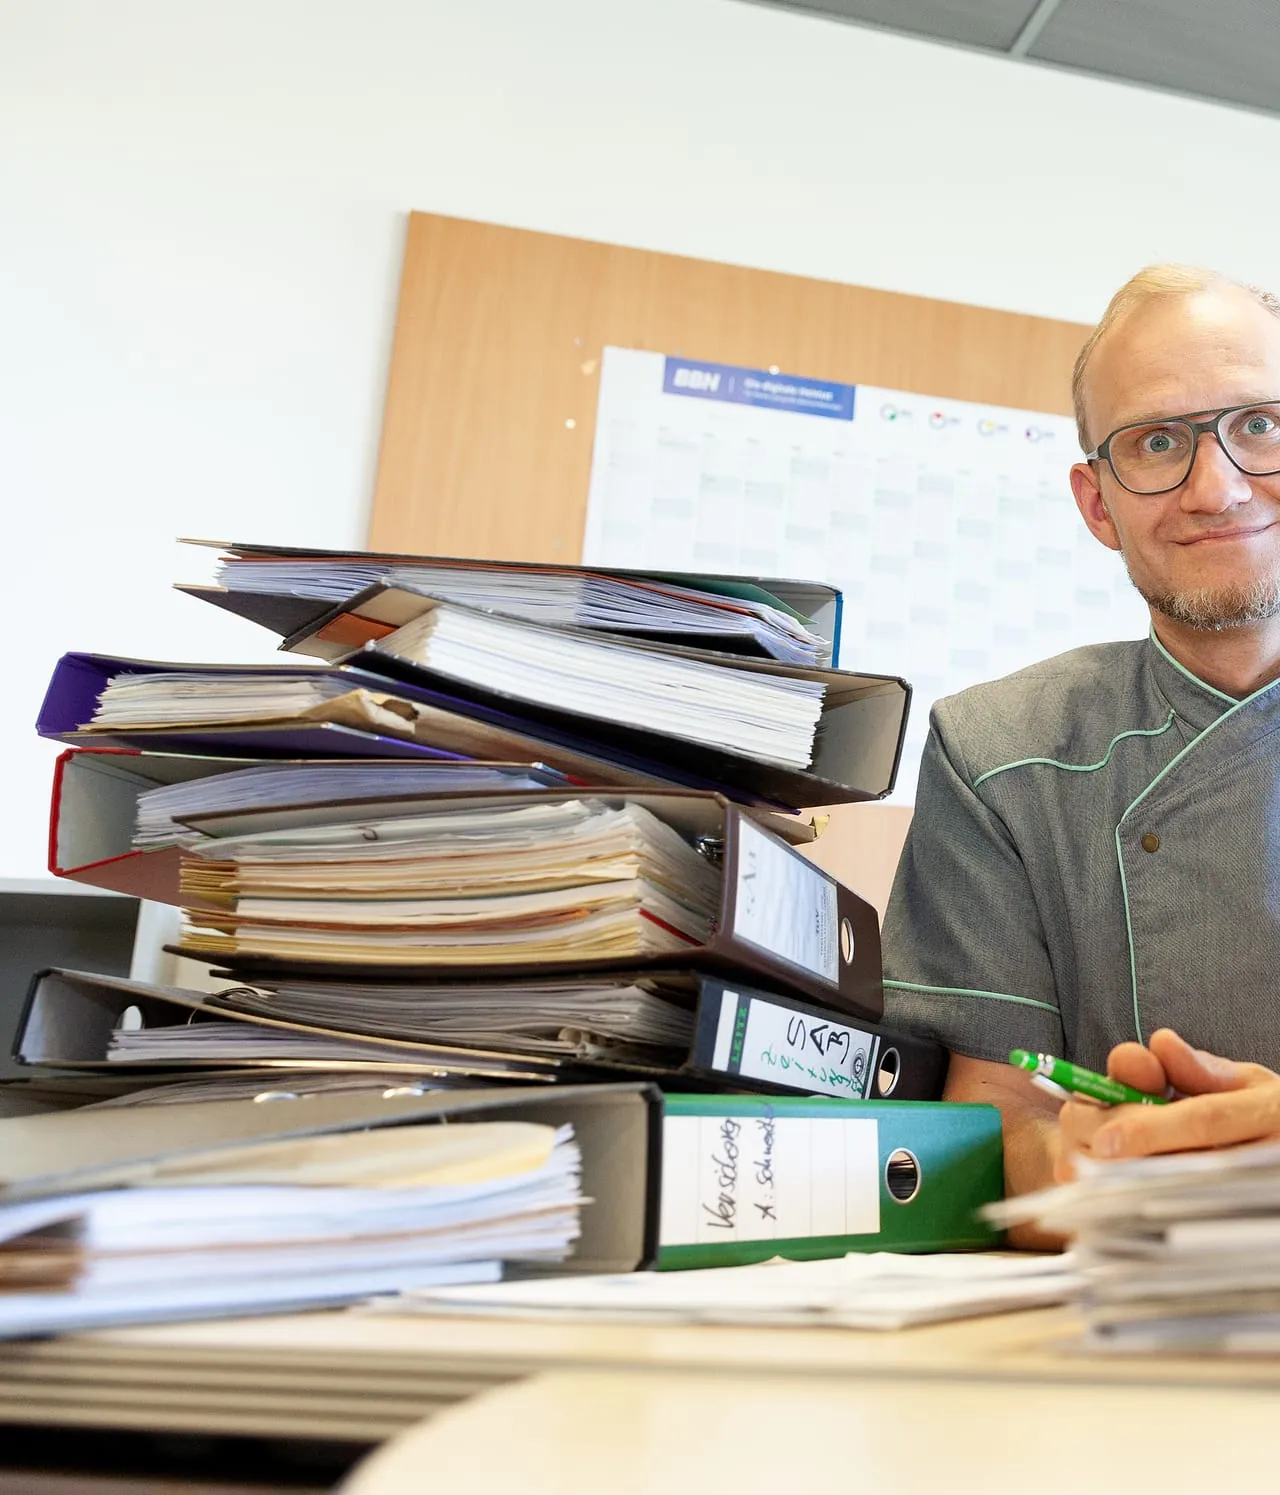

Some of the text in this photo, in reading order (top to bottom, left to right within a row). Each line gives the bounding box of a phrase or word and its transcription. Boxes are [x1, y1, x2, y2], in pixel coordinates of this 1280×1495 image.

[673, 367, 721, 392] BBN
[731, 1007, 748, 1063] LEITZ
[786, 1015, 850, 1064] SAB
